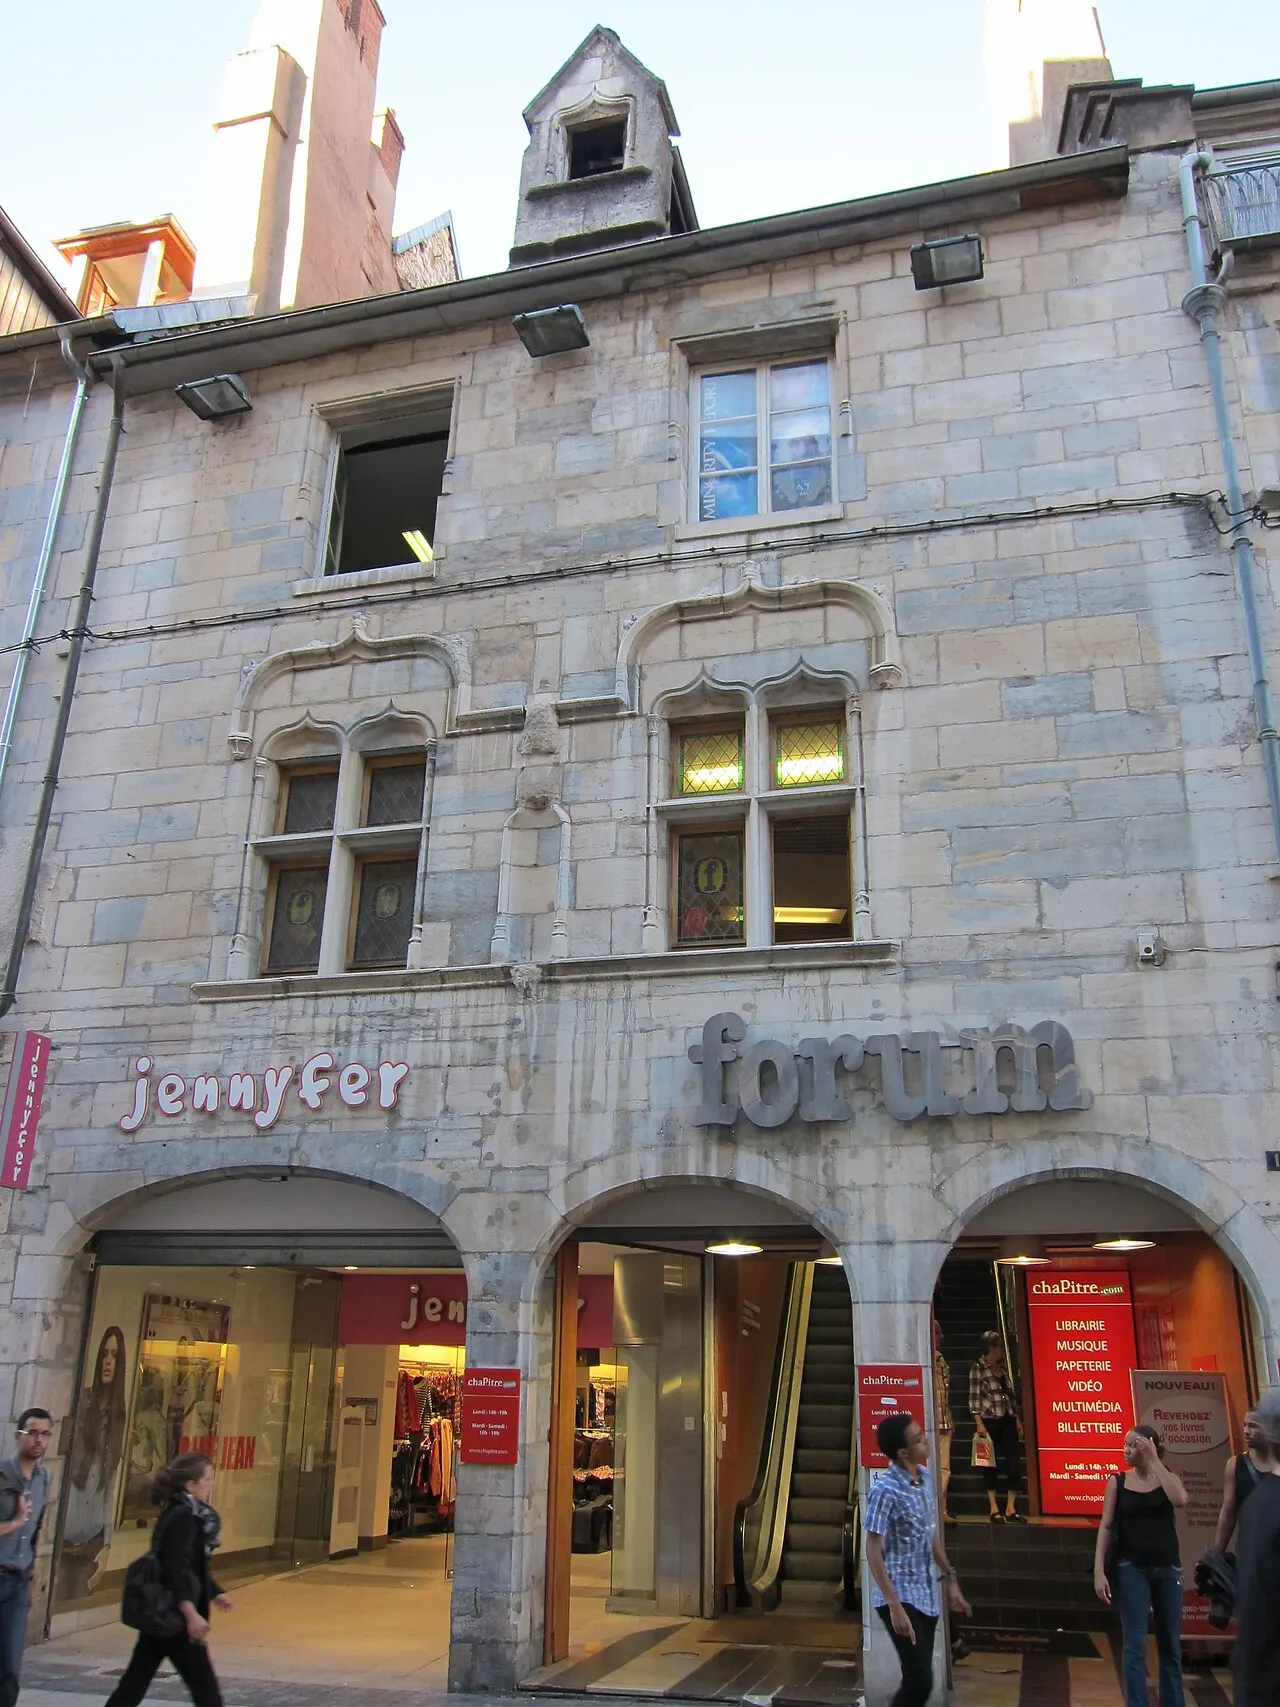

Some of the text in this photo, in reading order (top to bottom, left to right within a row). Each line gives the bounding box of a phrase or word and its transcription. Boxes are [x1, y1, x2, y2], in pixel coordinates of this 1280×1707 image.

[688, 1012, 1094, 1128] forum
[119, 1052, 409, 1132] jennyfer
[13, 1038, 42, 1182] jennyfer
[1056, 1320, 1106, 1331] LIBRAIRIE
[1057, 1341, 1108, 1352] MUSIQUE
[1056, 1361, 1112, 1371] PAPETERIE
[1068, 1380, 1103, 1392] VIDÉO
[1052, 1400, 1122, 1413] MULTIMÉDIA
[1058, 1422, 1122, 1434] BILLETTERIE
[1163, 1422, 1205, 1432] vos livres
[1160, 1434, 1211, 1443] d'occasion
[219, 1435, 256, 1470] JEAN
